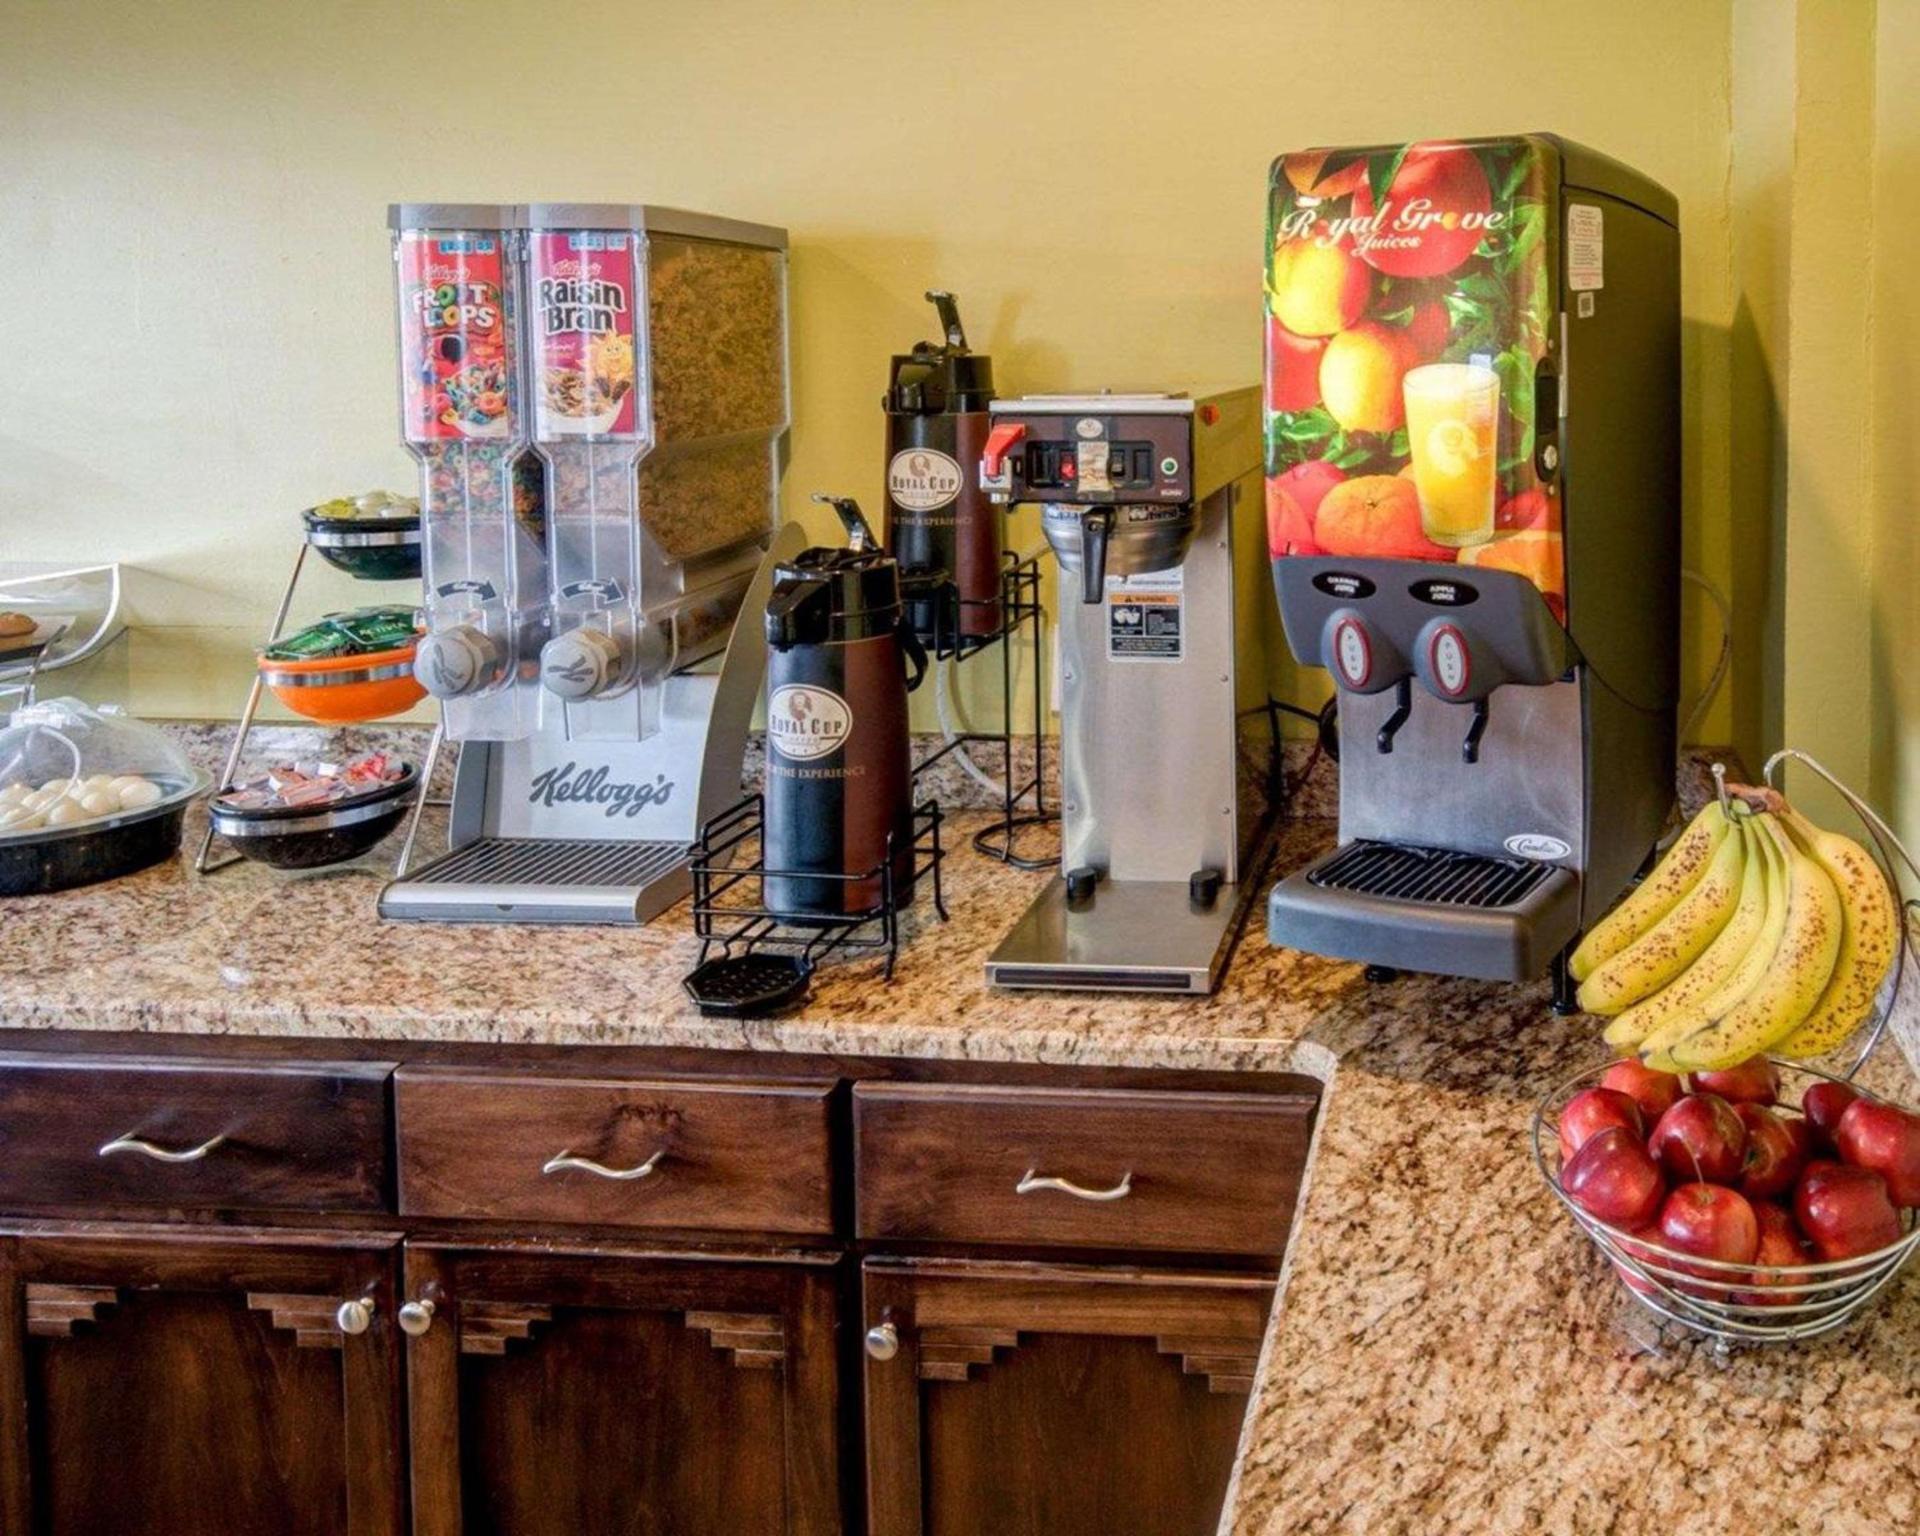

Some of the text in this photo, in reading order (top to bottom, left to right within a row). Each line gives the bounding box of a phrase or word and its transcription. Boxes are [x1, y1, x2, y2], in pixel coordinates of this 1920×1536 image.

[1277, 198, 1508, 247] Royal Grove
[1351, 233, 1422, 257] Juices
[538, 278, 624, 310] Raisin
[422, 305, 496, 328] LOOPS
[547, 306, 615, 334] Bran
[929, 476, 955, 489] CUP
[771, 715, 842, 735] ROYAL CUP
[528, 761, 675, 818] Kellogg's
